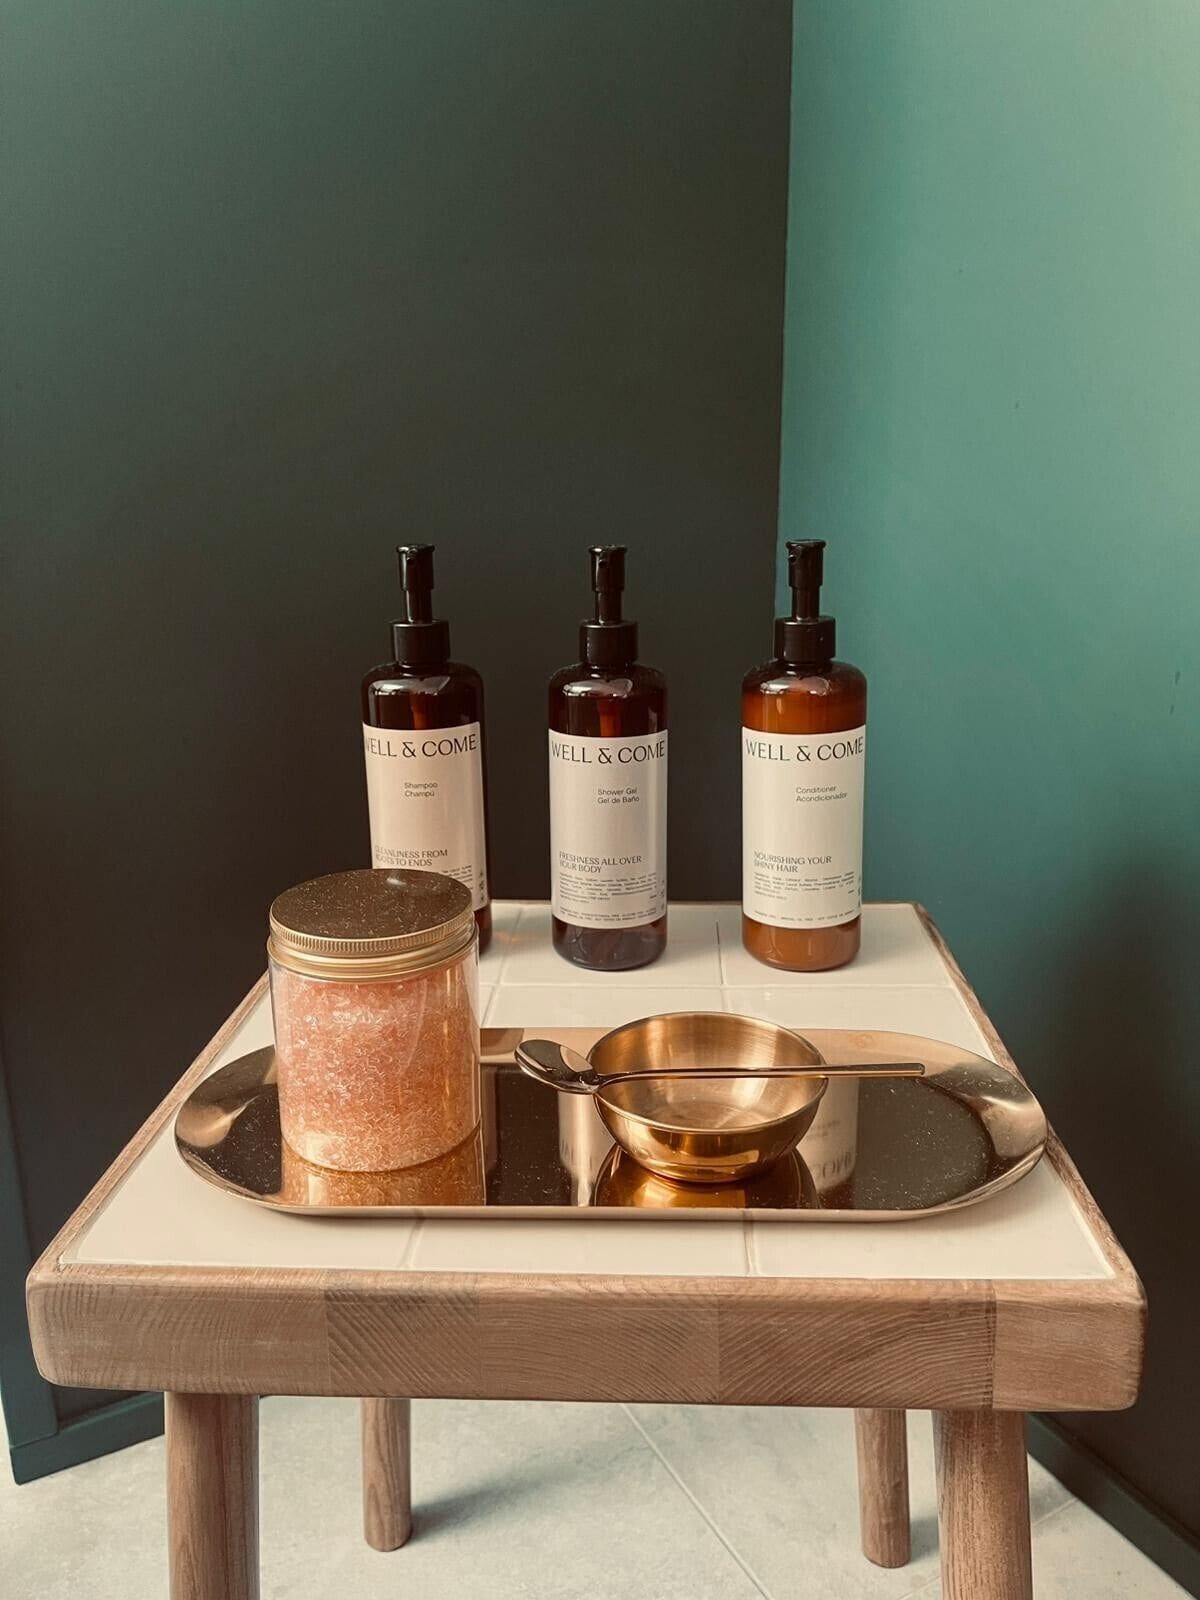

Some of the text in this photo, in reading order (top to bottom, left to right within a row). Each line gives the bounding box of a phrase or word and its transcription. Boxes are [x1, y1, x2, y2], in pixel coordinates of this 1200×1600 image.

[367, 734, 476, 758] ELL & COME
[746, 736, 864, 762] WELL & COME
[551, 740, 665, 764] WELL & COME
[404, 782, 438, 790] Shampoo
[795, 785, 837, 794] Conditioner
[598, 787, 638, 796] Shower Gel
[795, 791, 848, 802] Acondicionador
[611, 796, 621, 804] de
[622, 795, 640, 804] Baño
[421, 849, 448, 858] FROM
[559, 851, 643, 866] FRESHNESS ALL OVER
[753, 850, 832, 865] NOURISHING YOUR
[408, 859, 433, 867] ENDS
[776, 863, 800, 873] HAIR
[578, 864, 602, 874] BODY
